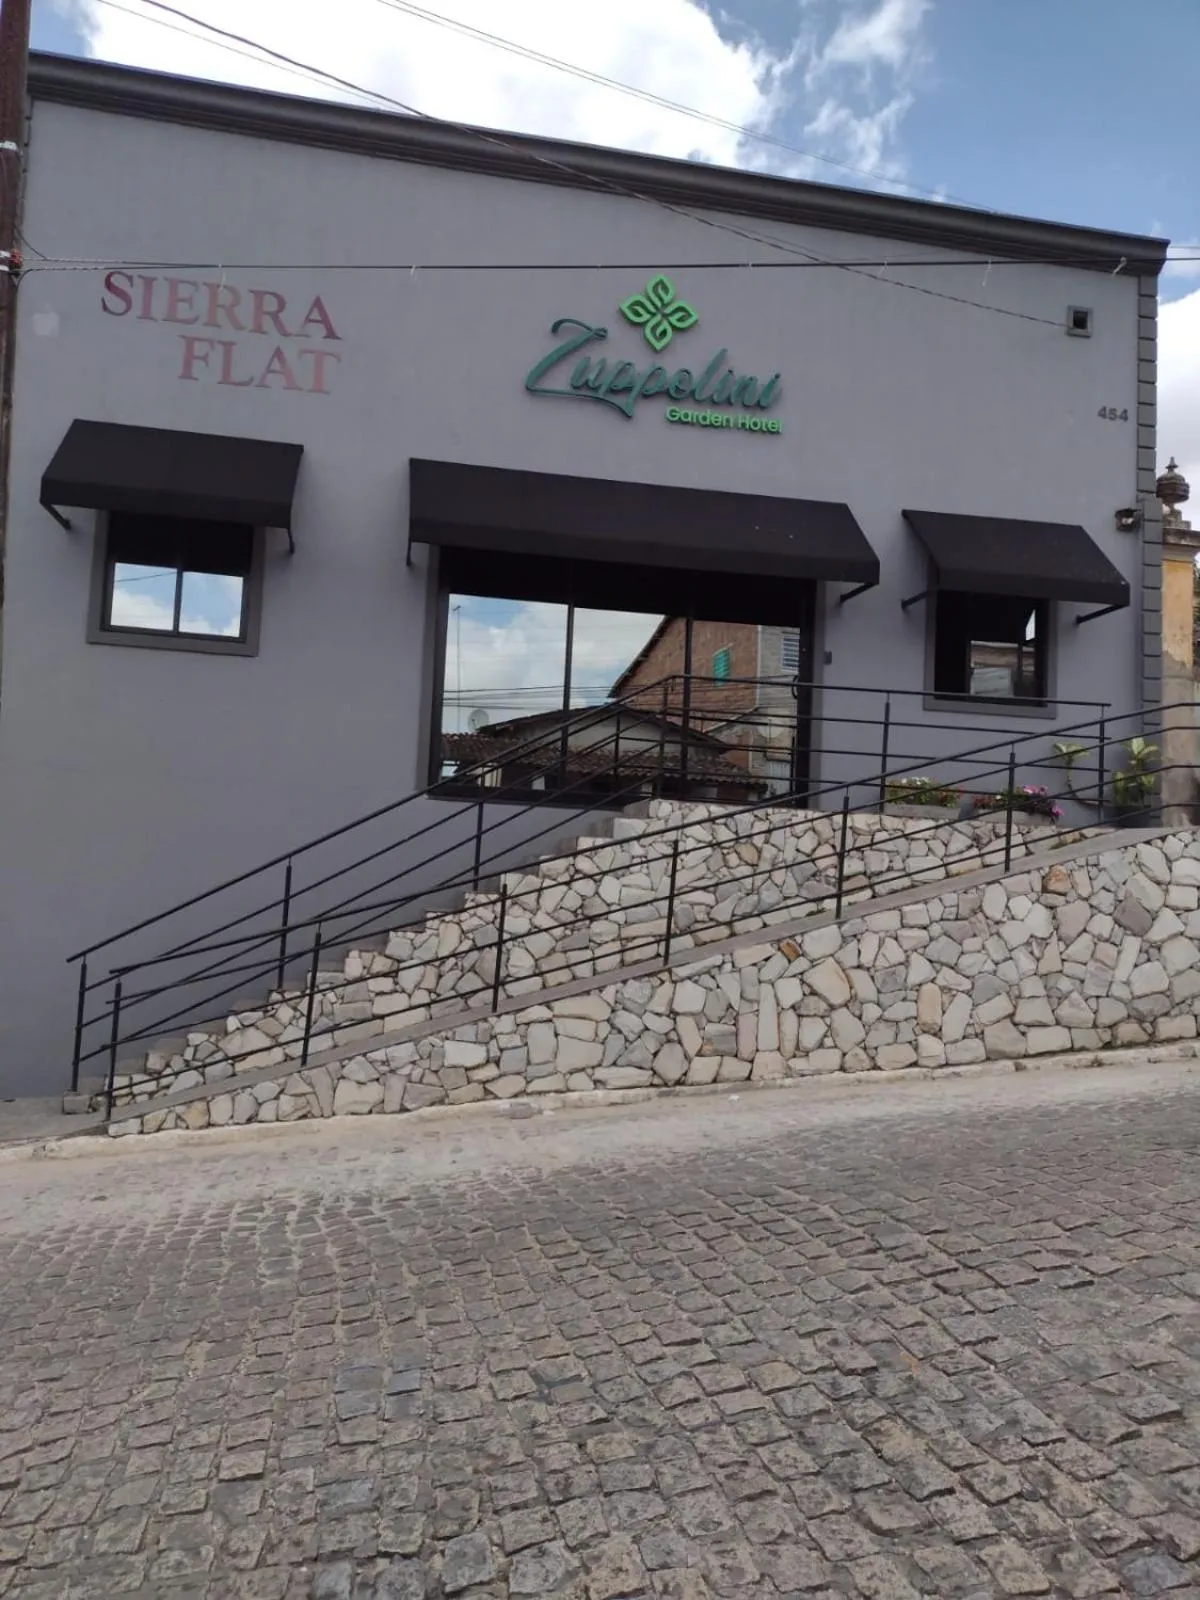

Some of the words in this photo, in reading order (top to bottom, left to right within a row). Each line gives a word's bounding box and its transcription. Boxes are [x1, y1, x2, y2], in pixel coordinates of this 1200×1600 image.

[101, 270, 342, 340] SIERRA
[176, 333, 342, 396] FLAT
[525, 318, 783, 419] Zuppolini
[665, 405, 734, 429] Garden
[738, 414, 783, 434] Hotel
[1097, 405, 1129, 422] 454
